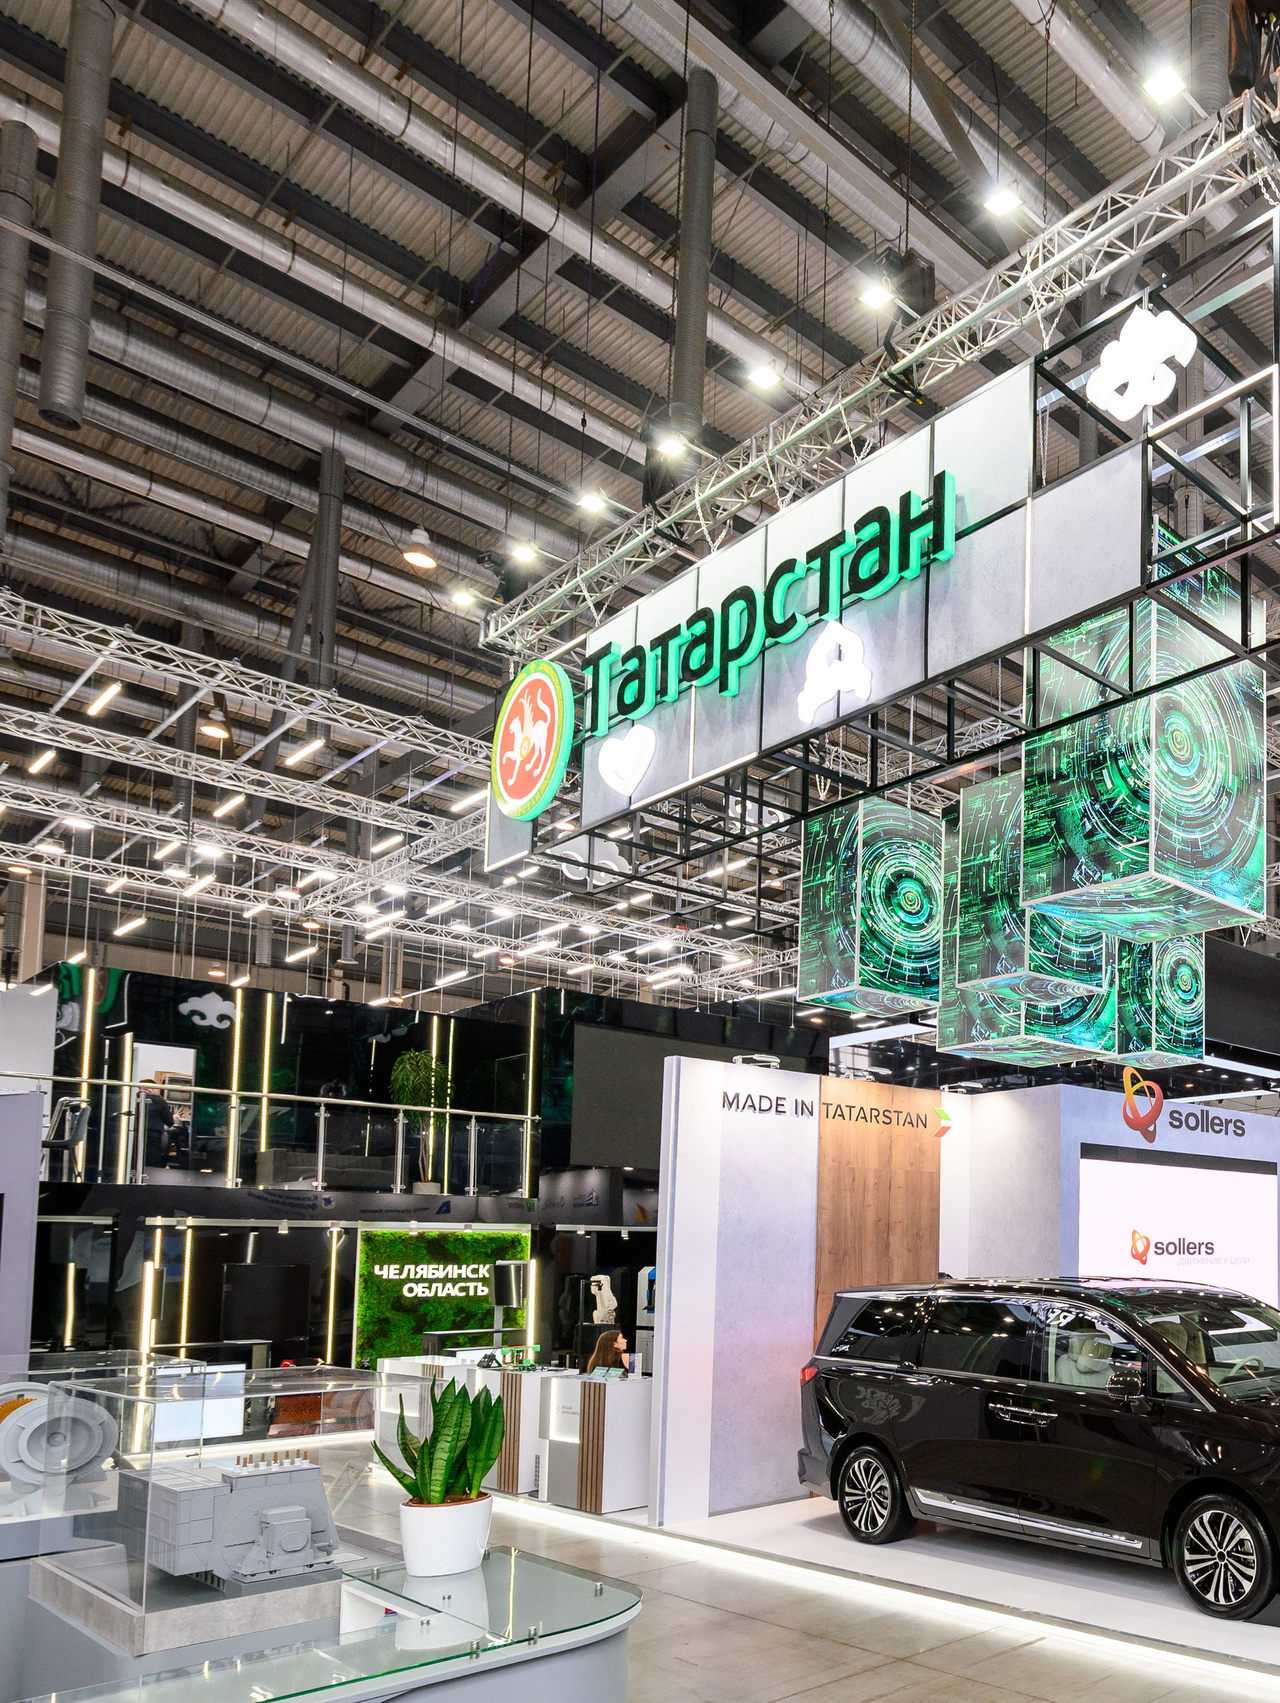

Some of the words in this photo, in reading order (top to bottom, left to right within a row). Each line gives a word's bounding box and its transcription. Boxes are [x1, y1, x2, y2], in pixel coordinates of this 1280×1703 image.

[581, 469, 952, 737] Татарстан
[722, 1091, 787, 1114] MADE
[794, 1099, 814, 1118] IN
[822, 1102, 928, 1129] TATARSTAN
[1168, 1109, 1246, 1137] sollers
[1153, 1238, 1215, 1255] sollers
[1178, 1257, 1222, 1266] движение
[1231, 1256, 1251, 1265] цели
[402, 1282, 489, 1298] ОБЛАСТЬ
